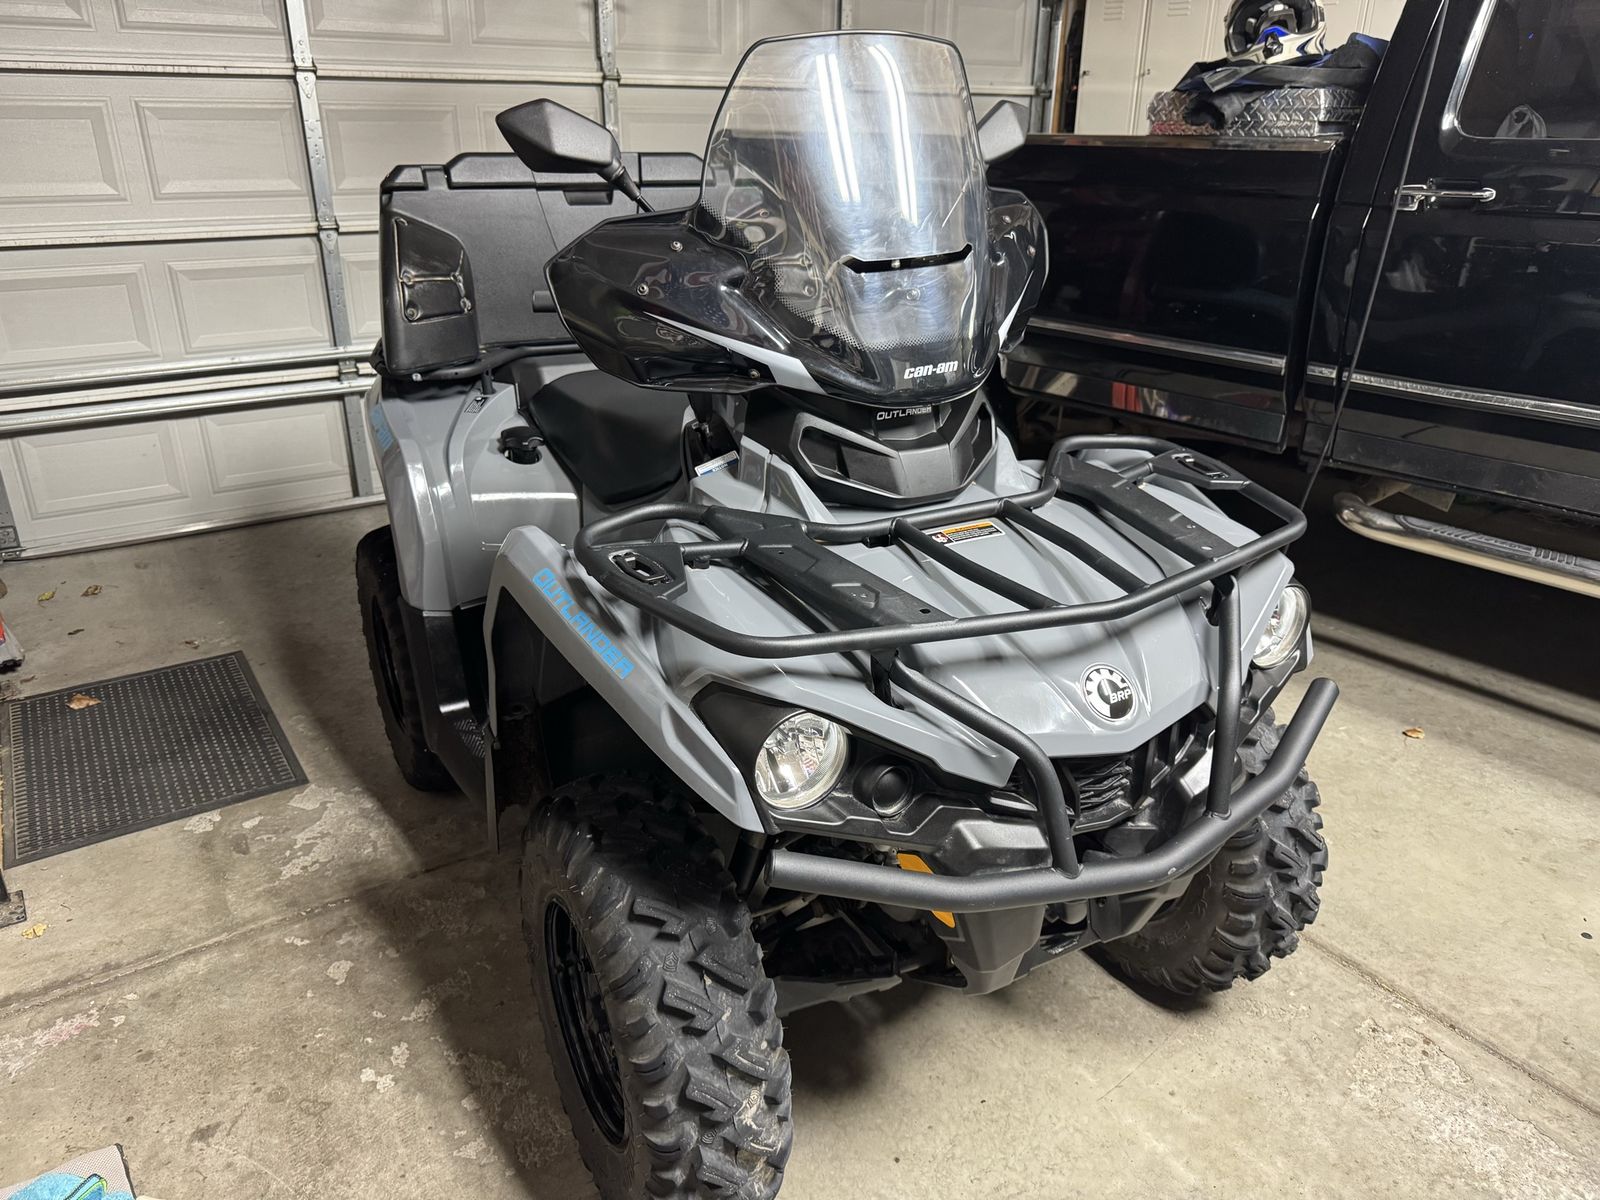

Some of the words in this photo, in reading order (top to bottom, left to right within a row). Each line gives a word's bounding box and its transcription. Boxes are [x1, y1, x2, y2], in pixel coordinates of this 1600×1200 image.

[904, 361, 958, 379] can-am
[876, 406, 931, 420] OUTLANDER
[533, 568, 635, 680] OUTLANDER
[1110, 689, 1132, 704] BRP
